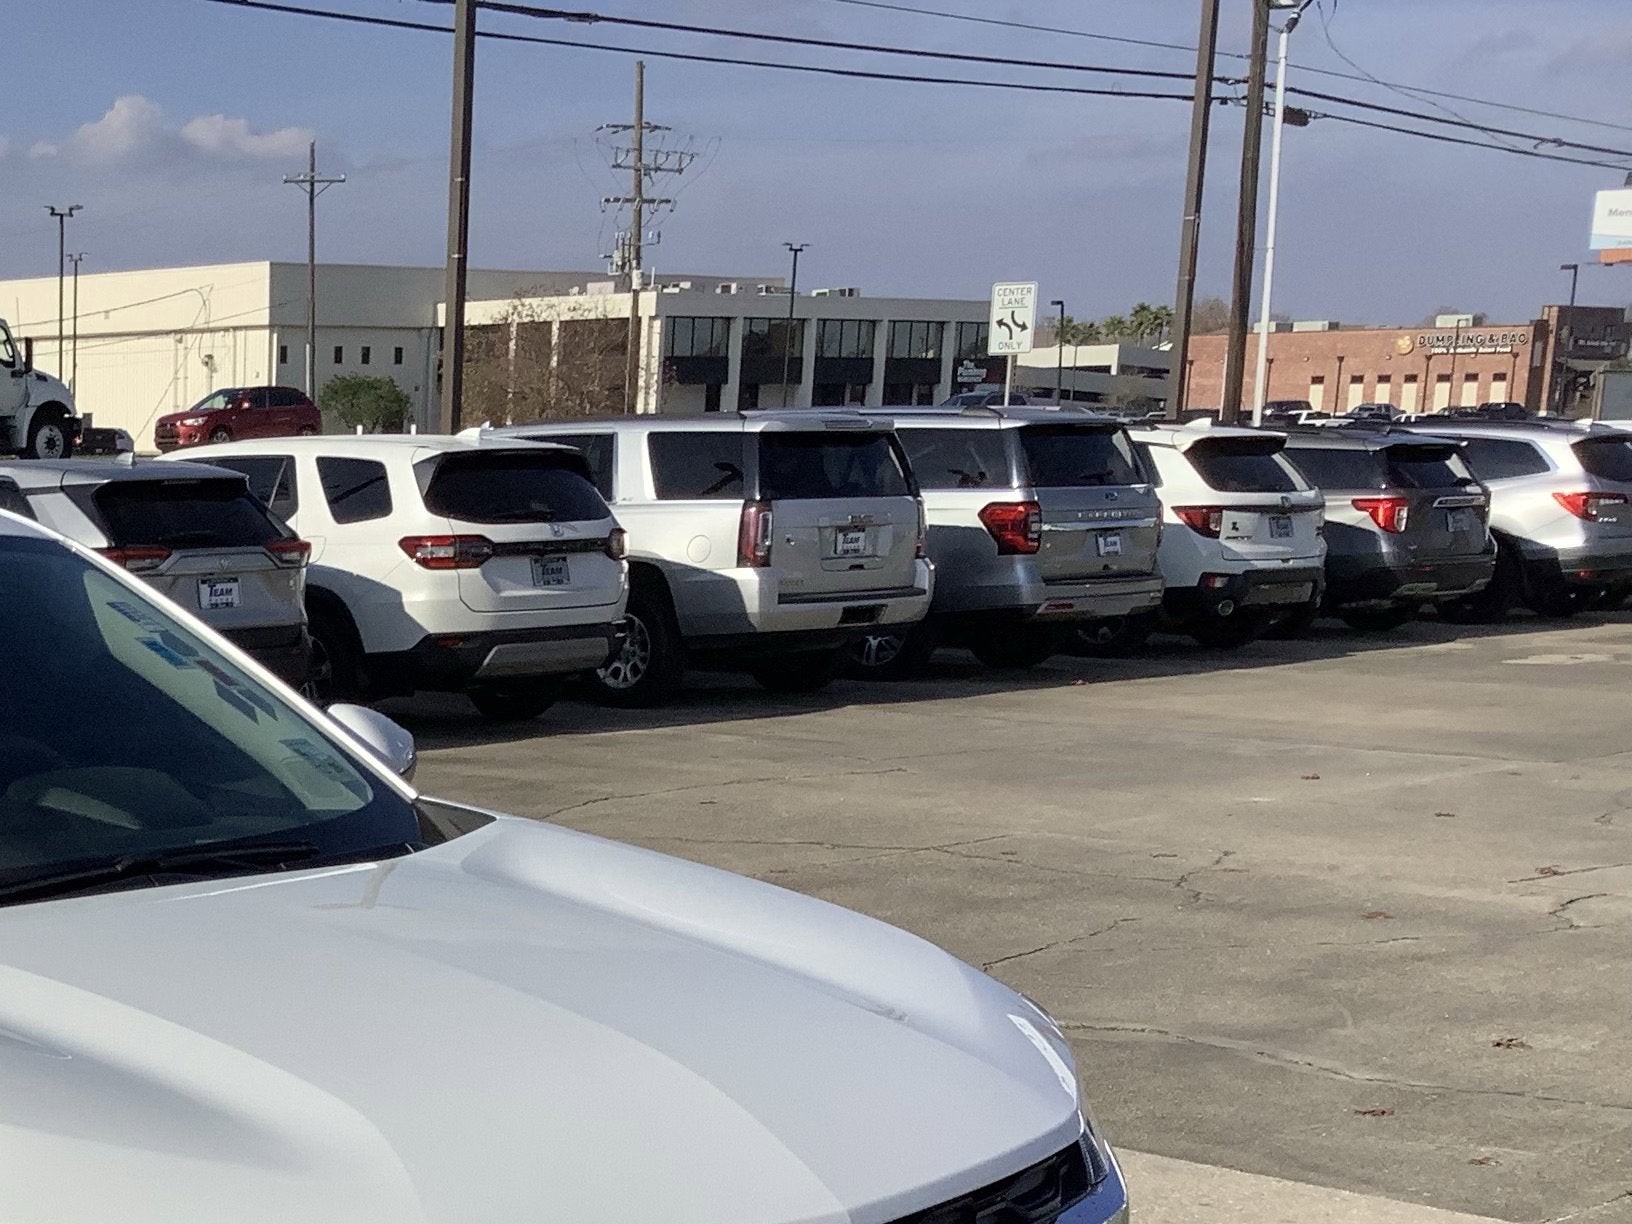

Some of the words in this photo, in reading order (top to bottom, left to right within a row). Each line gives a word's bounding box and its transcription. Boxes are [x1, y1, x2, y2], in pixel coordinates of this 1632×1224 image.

[997, 287, 1032, 297] CENTER
[1001, 297, 1026, 306] LANE
[1487, 332, 1499, 346] &
[998, 341, 1024, 351] ONLY
[208, 584, 233, 598] TEAM
